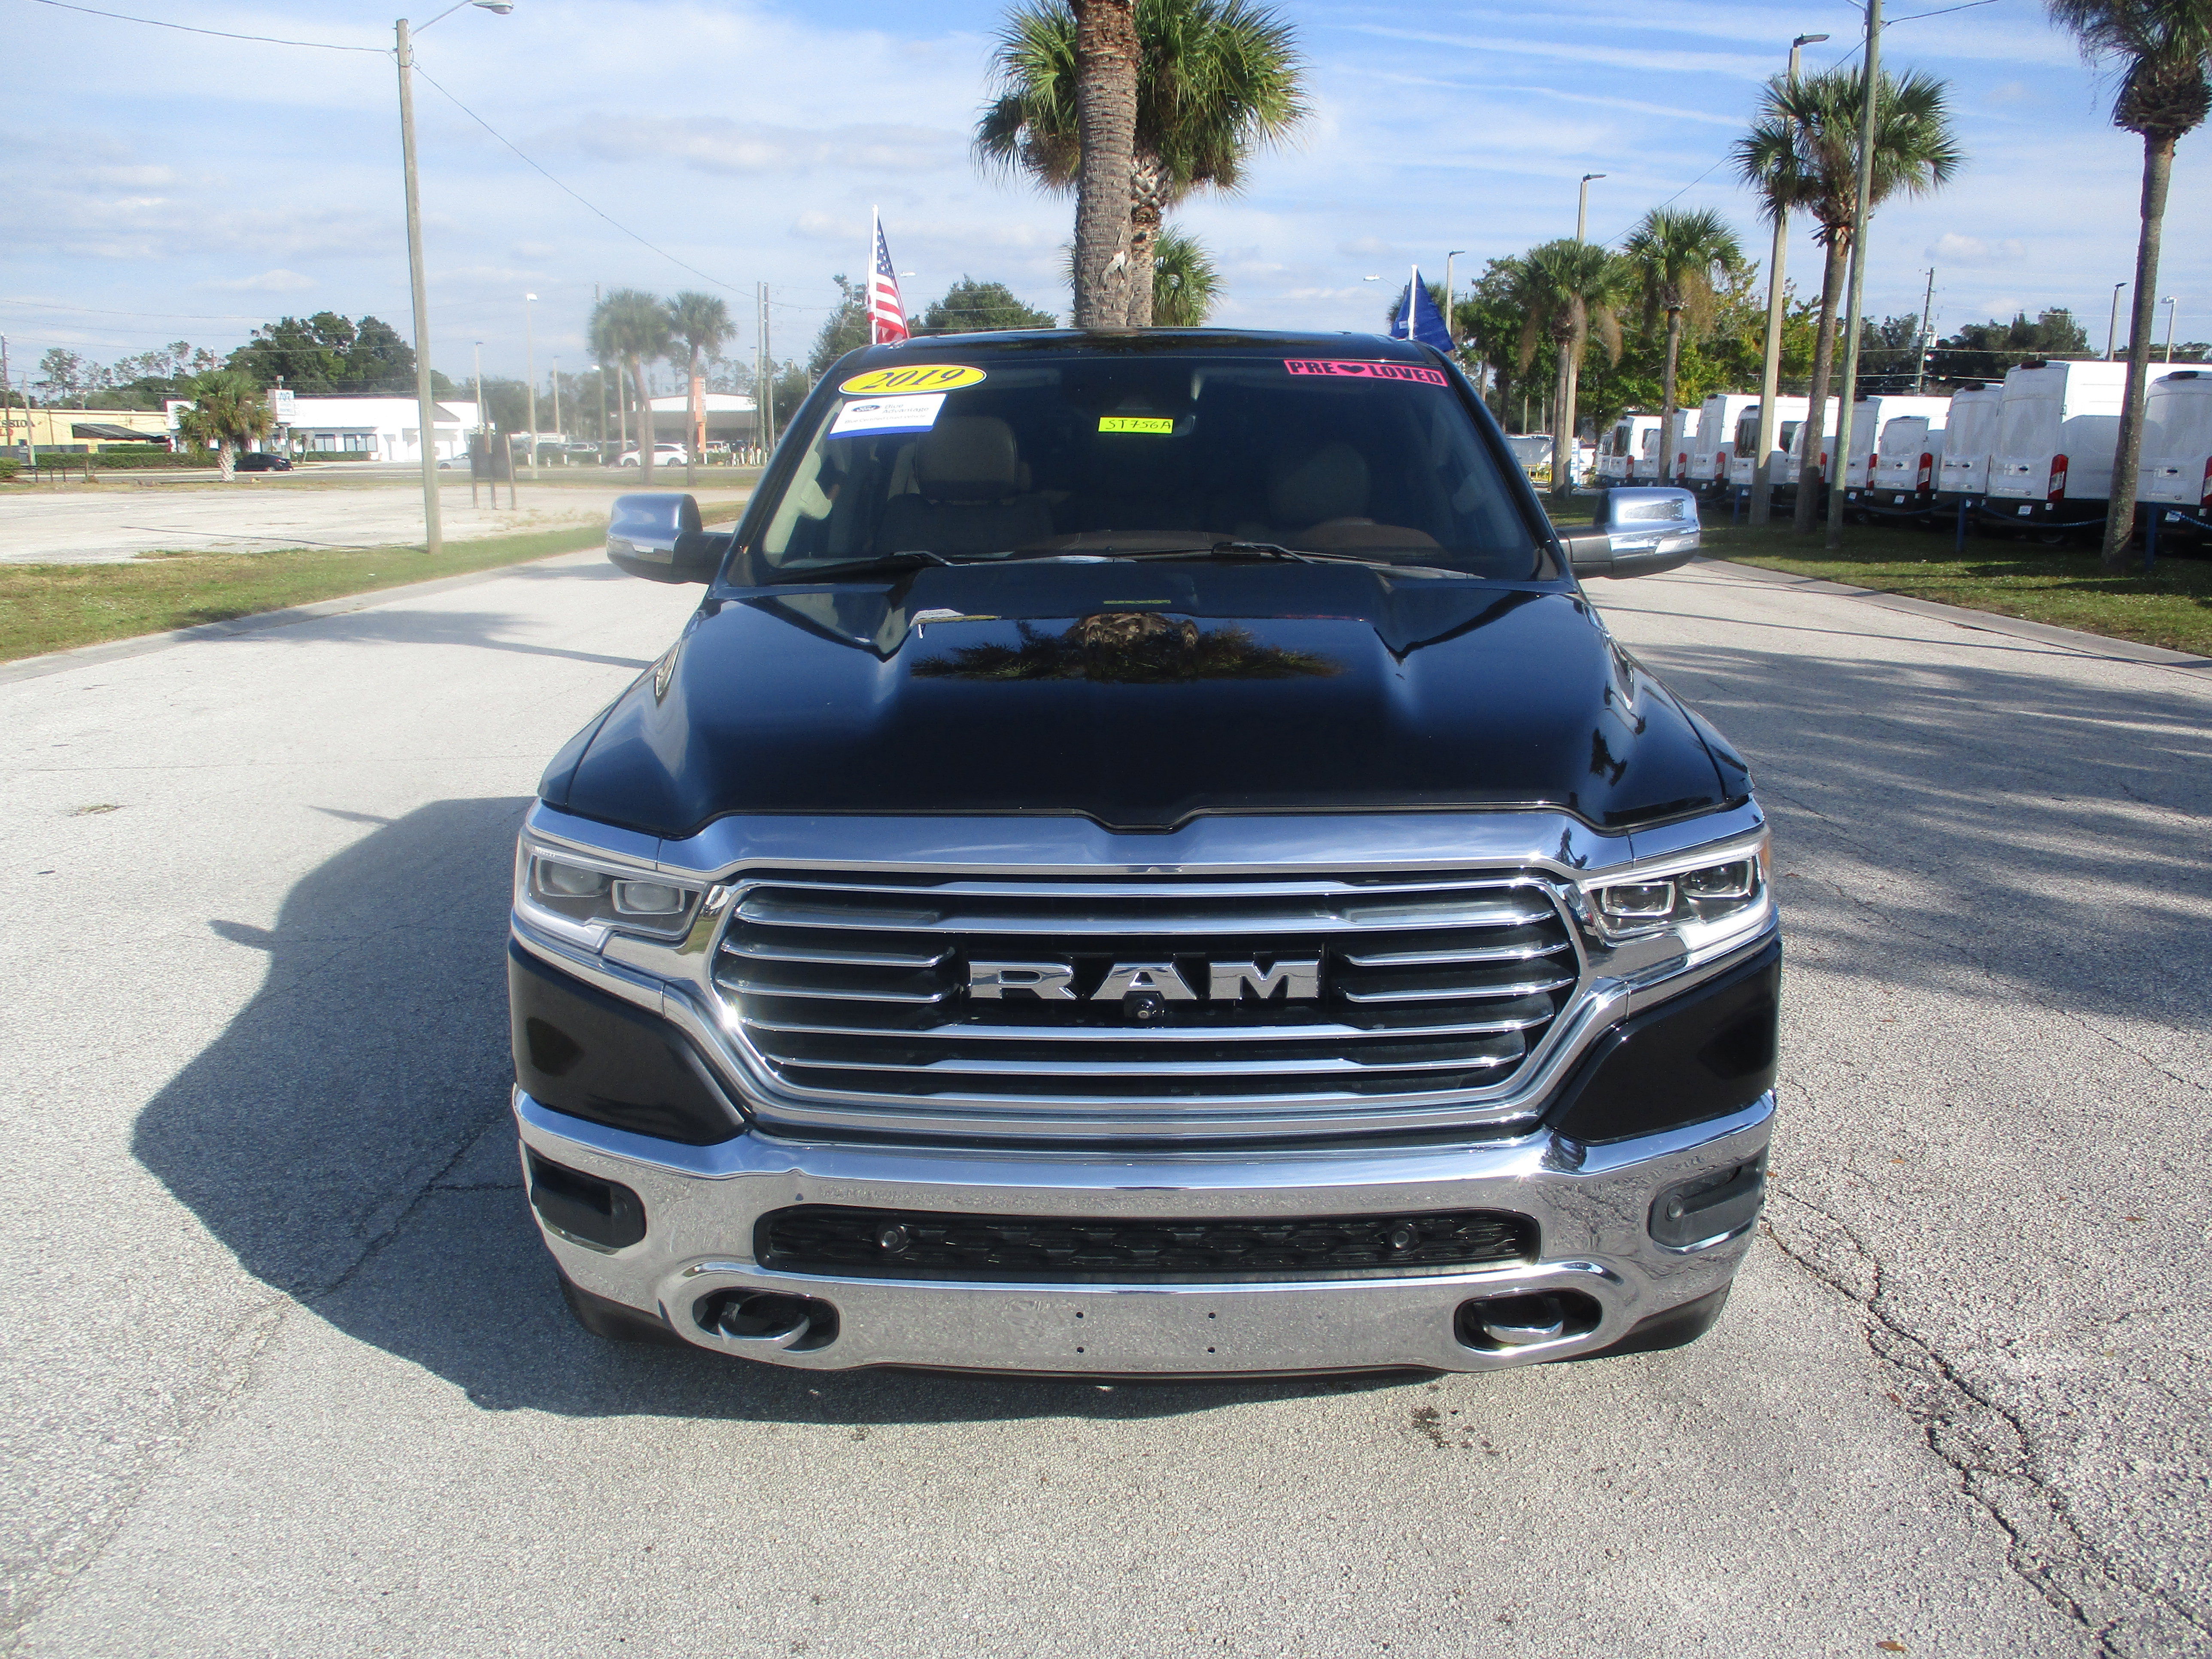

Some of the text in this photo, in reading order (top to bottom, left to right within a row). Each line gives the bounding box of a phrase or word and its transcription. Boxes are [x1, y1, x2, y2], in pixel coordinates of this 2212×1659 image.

[859, 369, 965, 390] 2019
[1288, 362, 1444, 384] PRE LOVED
[1105, 419, 1171, 429] ST756A
[968, 960, 1321, 1002] RAM
